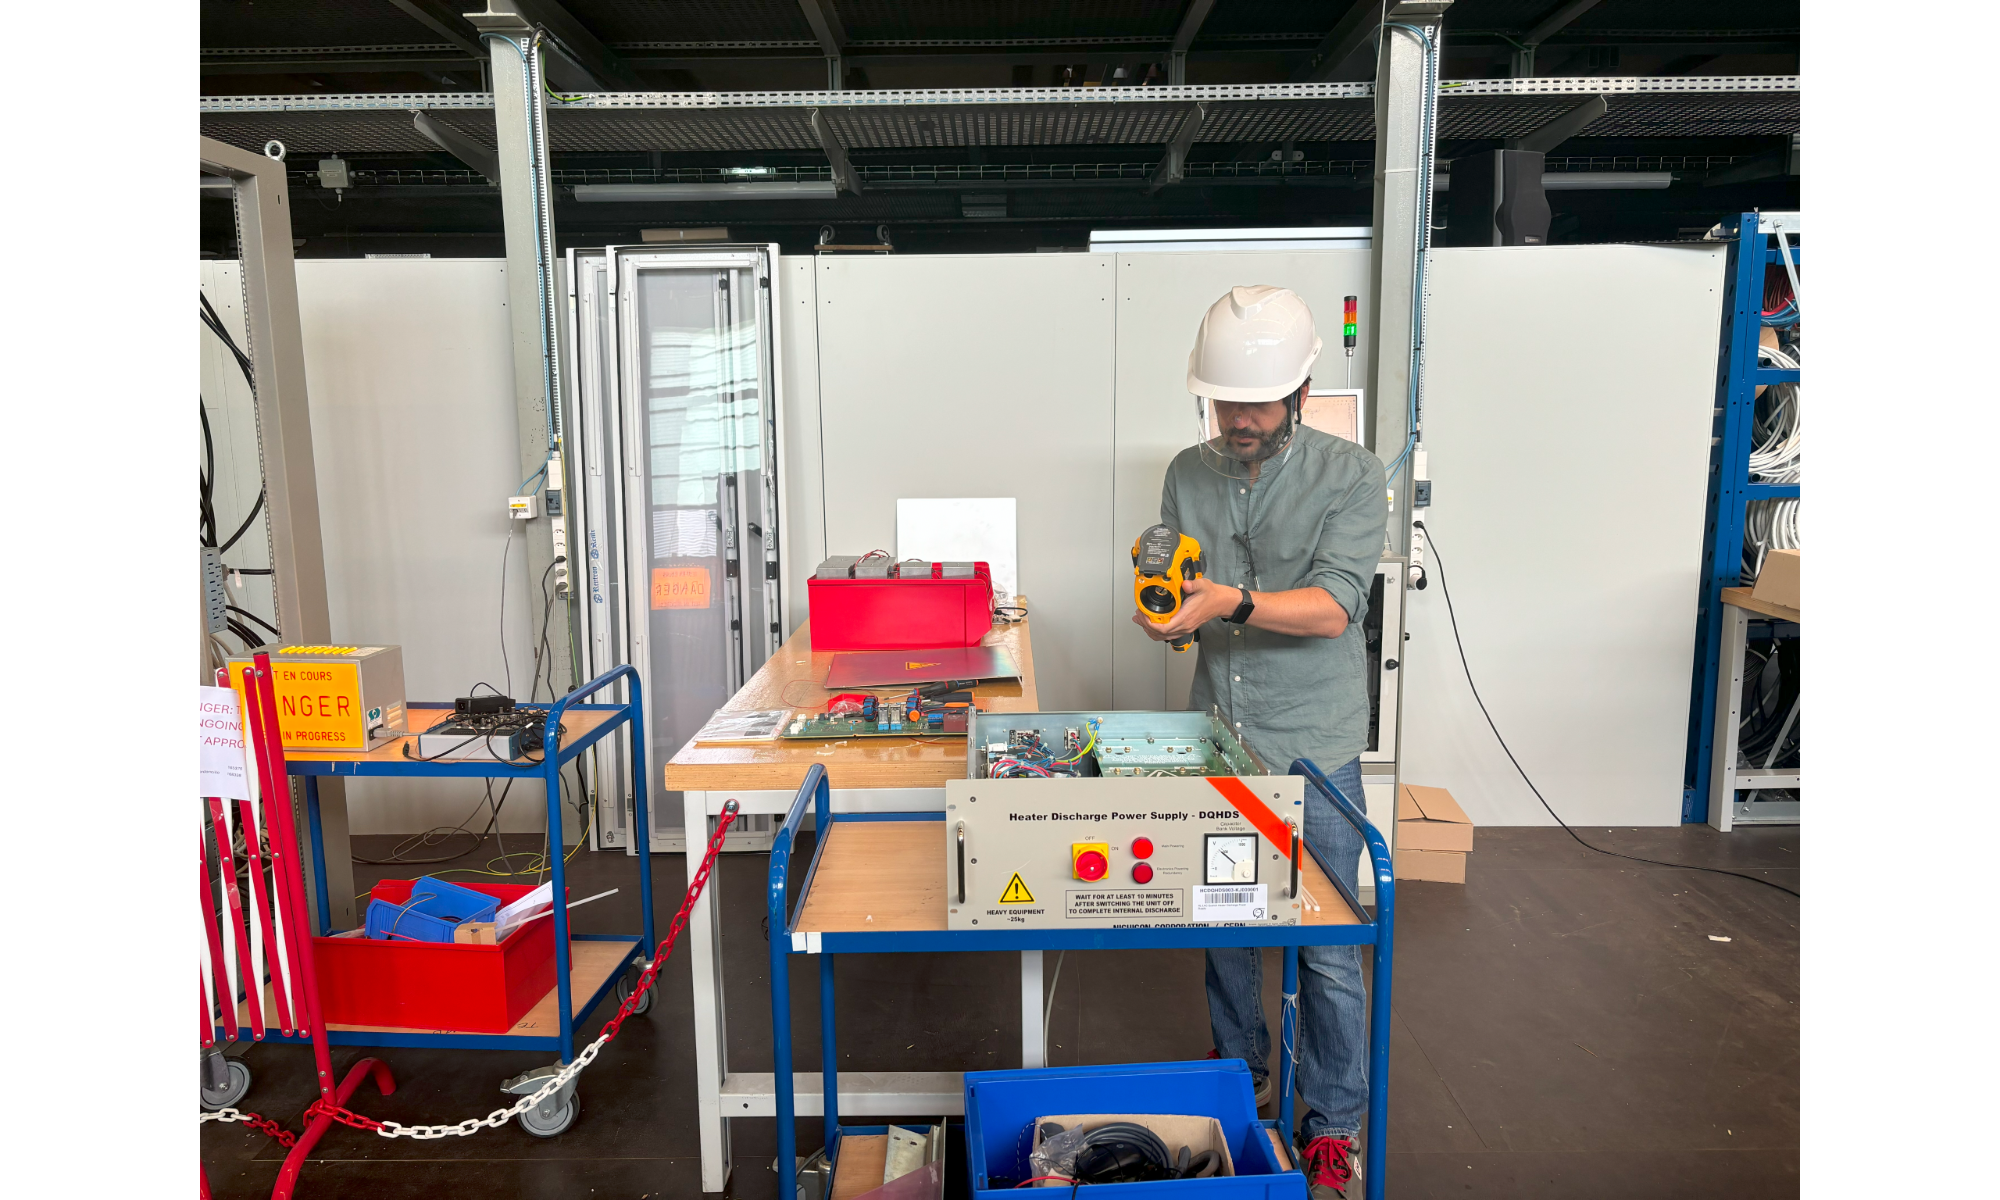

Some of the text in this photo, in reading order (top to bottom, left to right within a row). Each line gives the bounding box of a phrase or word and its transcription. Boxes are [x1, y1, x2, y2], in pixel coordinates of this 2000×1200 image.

[284, 671, 296, 680] EN
[300, 671, 332, 681] COURS
[283, 695, 350, 717] NGER
[283, 731, 346, 741] IN PROGRESS
[1051, 812, 1108, 822] Discharge
[1112, 812, 1147, 820] Power
[1150, 811, 1188, 821] Supply
[1199, 810, 1240, 819] DQHDS
